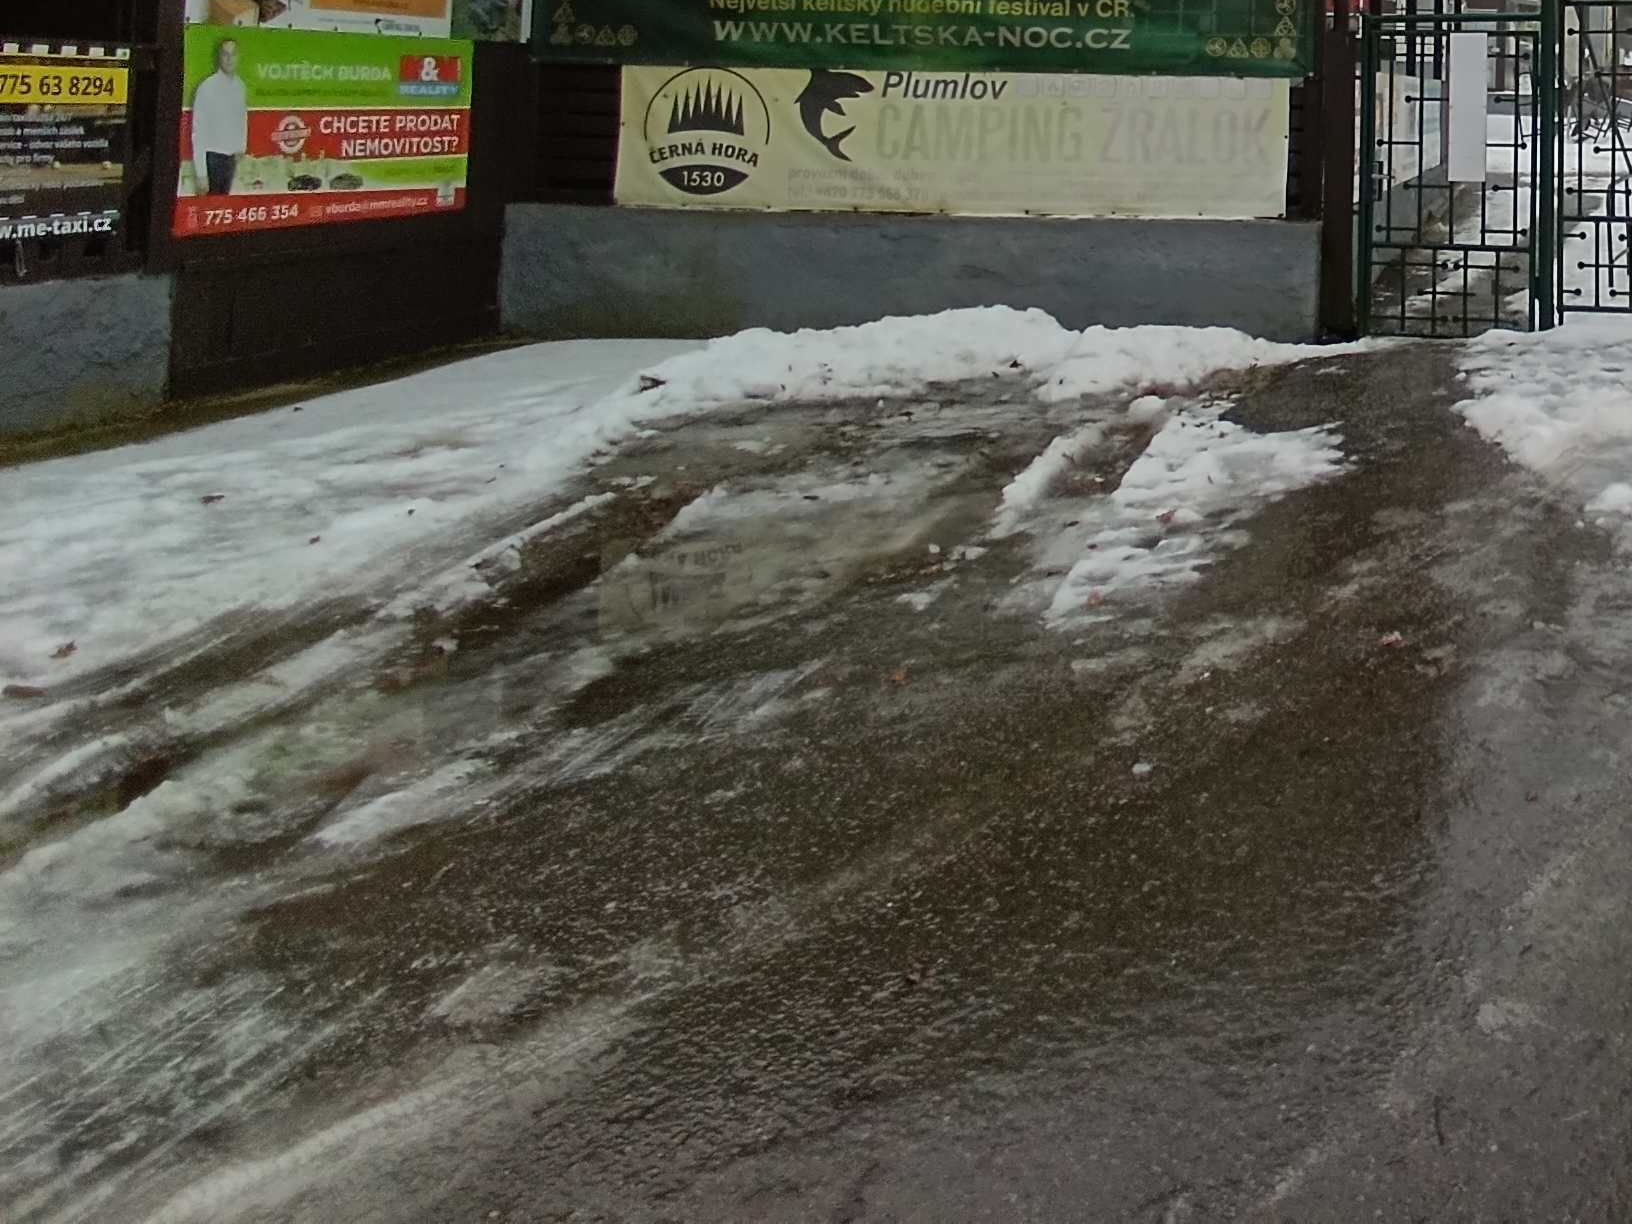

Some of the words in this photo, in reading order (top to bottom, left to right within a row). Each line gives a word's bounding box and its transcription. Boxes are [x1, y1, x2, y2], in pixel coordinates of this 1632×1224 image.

[1076, 3, 1089, 18] v
[712, 20, 1133, 50] WWW.KELTSKA-NOC.CZ
[38, 74, 63, 96] 63
[68, 75, 116, 97] 8294
[399, 84, 460, 97] REALITY
[881, 71, 1008, 100] Plumlov
[319, 116, 390, 134] CHCETE
[395, 114, 461, 131] PRODAT
[876, 103, 1083, 163] CAMPING
[1100, 101, 1272, 166] ŽRALOK
[341, 136, 460, 157] NEMOVITOST?
[649, 138, 706, 165] ČERNÁ
[711, 142, 760, 168] HORA
[682, 170, 725, 187] 1530
[205, 208, 232, 226] 775
[237, 206, 266, 223] 466
[270, 204, 299, 220] 354
